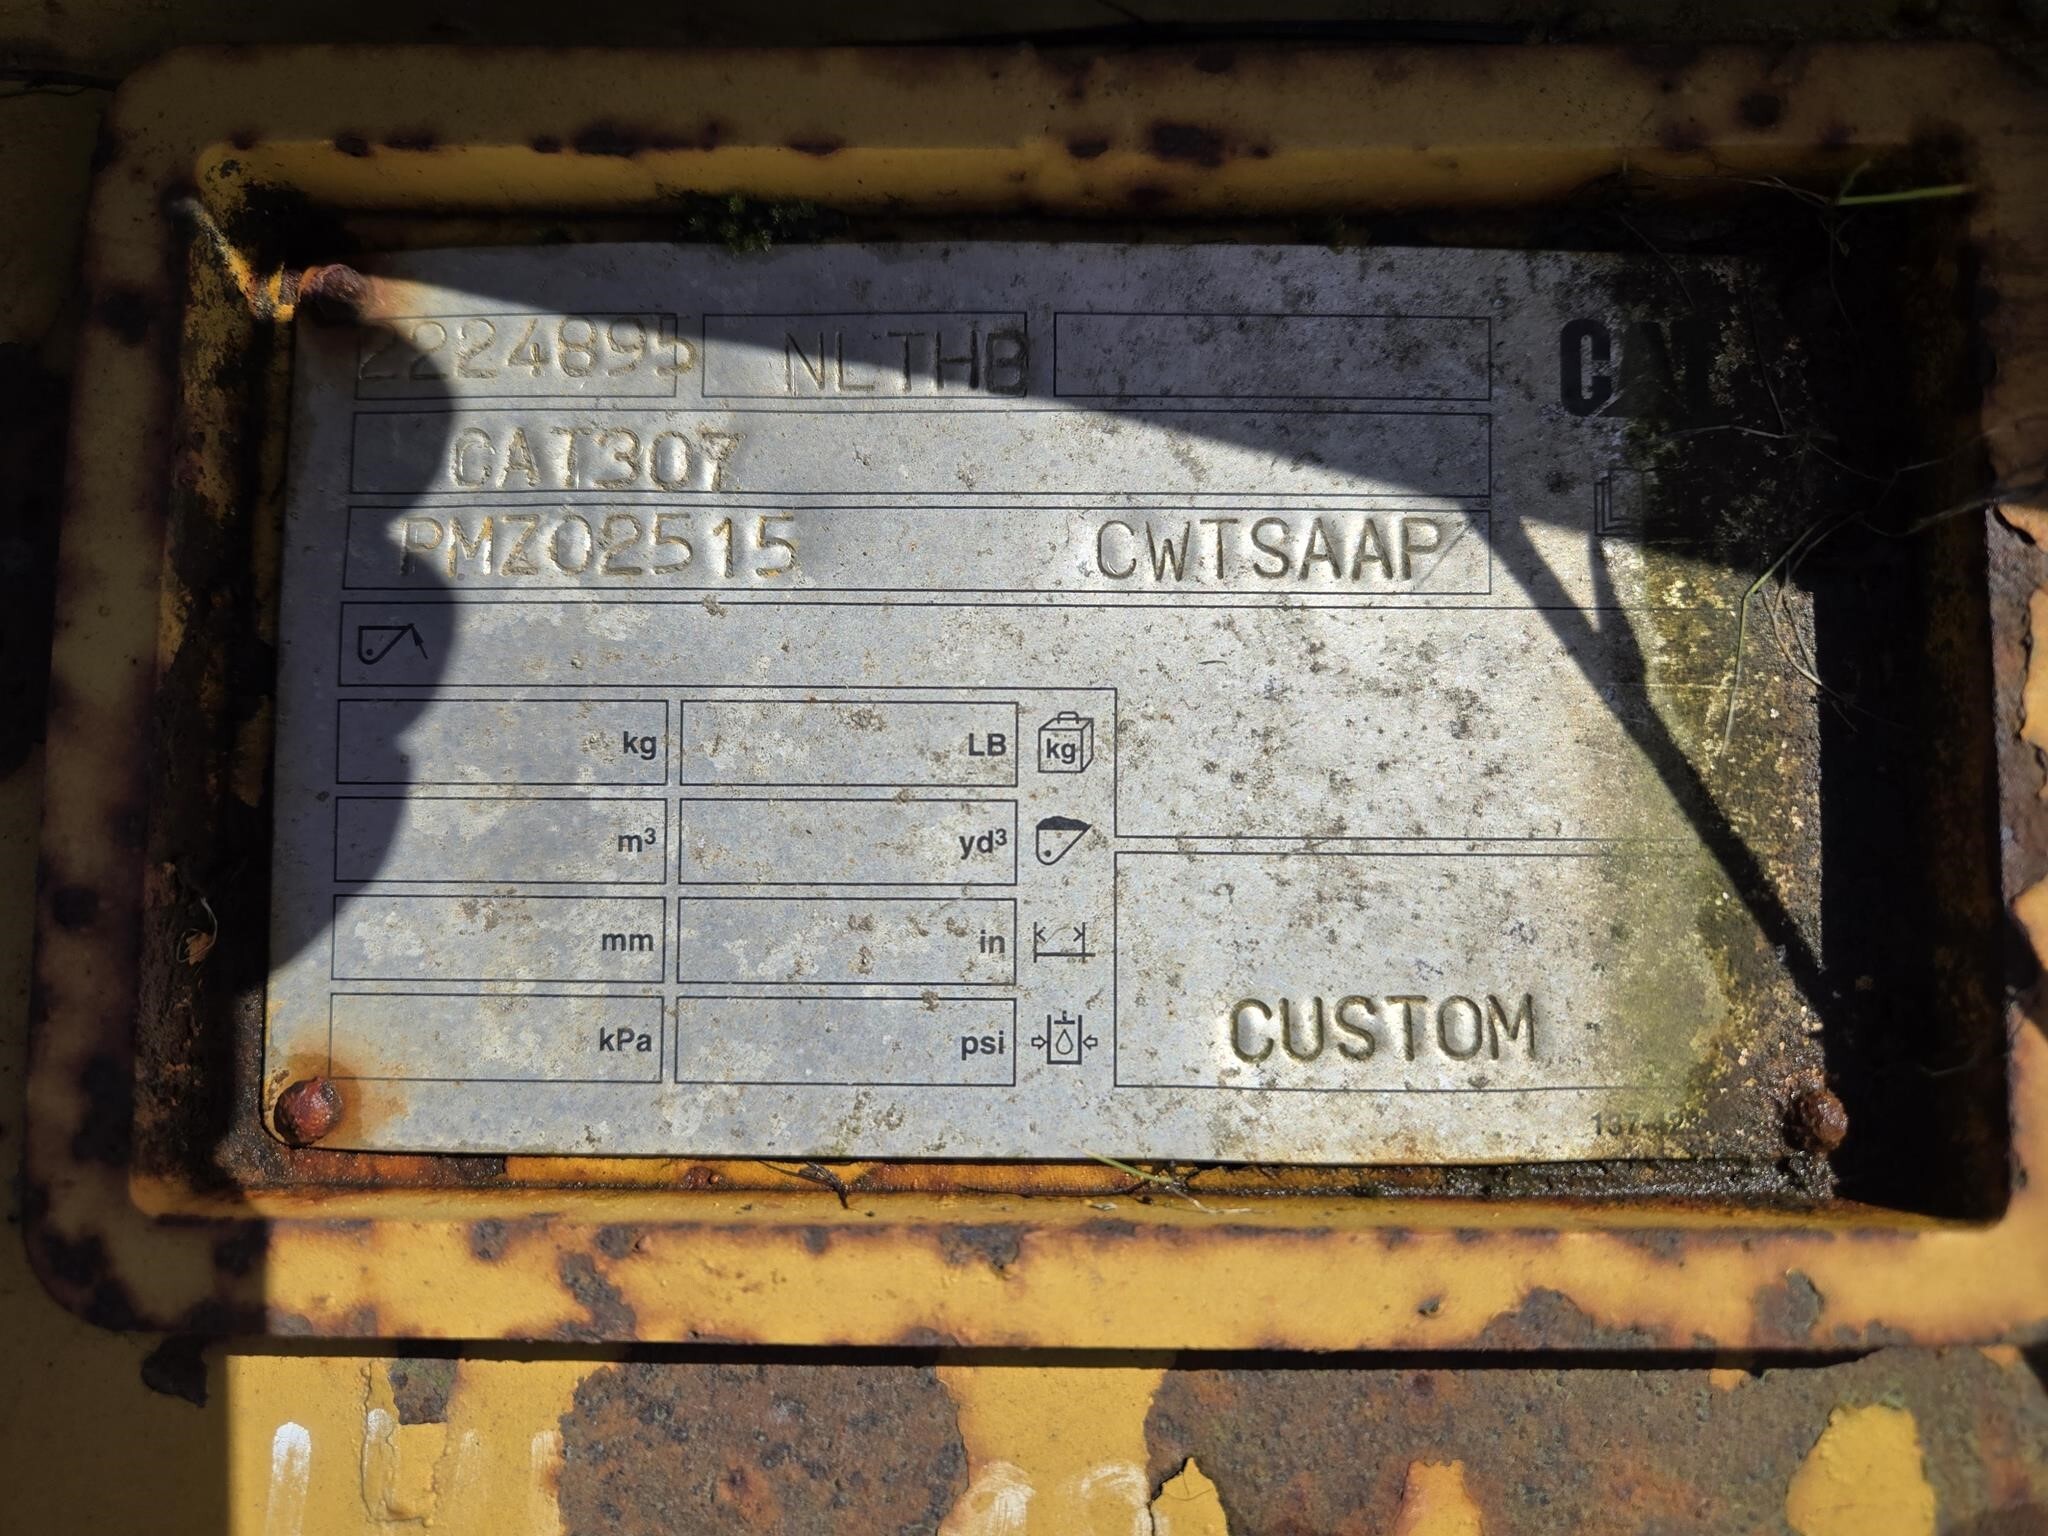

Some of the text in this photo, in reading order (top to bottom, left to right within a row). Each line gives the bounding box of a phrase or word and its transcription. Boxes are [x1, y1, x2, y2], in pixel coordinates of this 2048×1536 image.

[785, 330, 1030, 394] NLTHB
[453, 427, 744, 491] CAT307
[402, 513, 797, 578] PMZ02515
[1096, 516, 1442, 582] CWTSAAP
[623, 731, 657, 760] kg
[968, 733, 1006, 756] LB
[1046, 738, 1076, 764] kg
[601, 932, 654, 952] mm
[979, 929, 1006, 954] in
[600, 1027, 652, 1052] kPa
[1228, 994, 1535, 1063] CUSTOM
[961, 1030, 1005, 1060] psi
